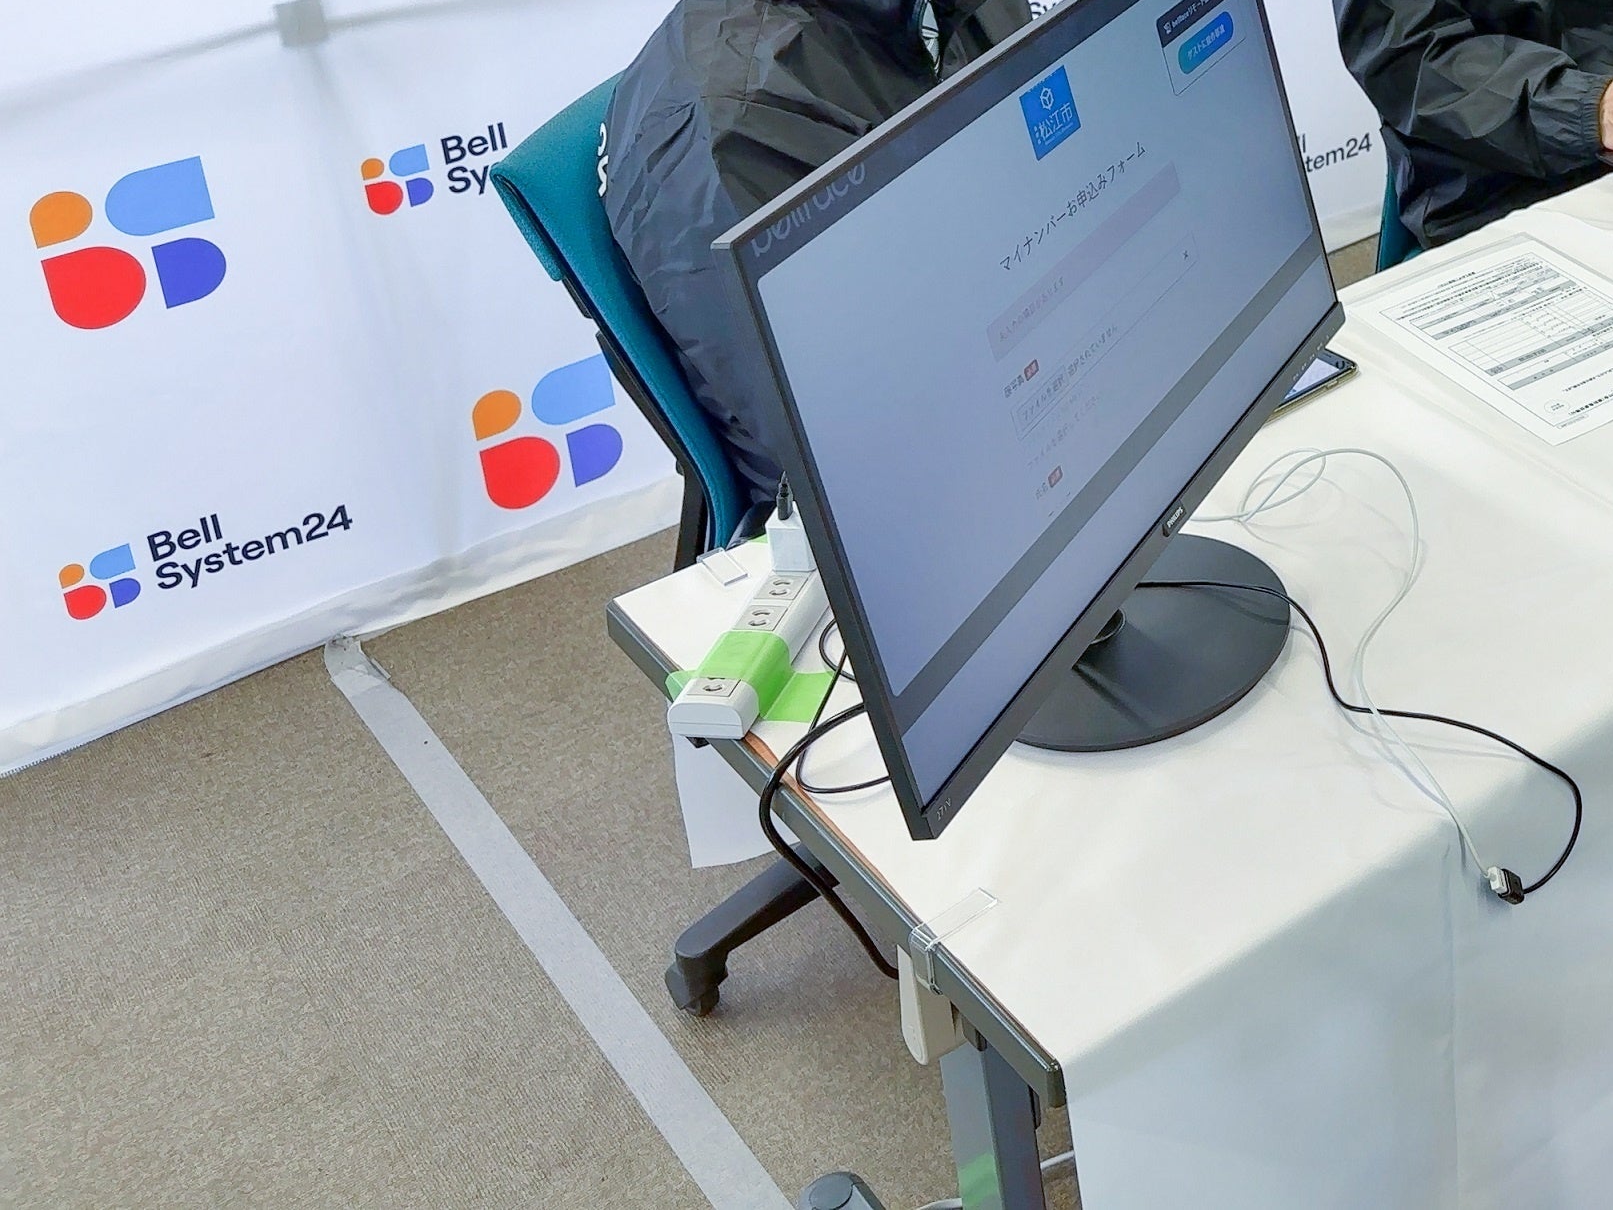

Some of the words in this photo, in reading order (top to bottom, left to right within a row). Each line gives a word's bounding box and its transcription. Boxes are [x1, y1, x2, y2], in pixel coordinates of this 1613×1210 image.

[440, 121, 508, 165] Bell
[1304, 132, 1373, 173] tem24
[999, 141, 1146, 272] マイナンバーお申込みフォーム
[147, 514, 224, 562] Bell
[156, 505, 353, 589] System24
